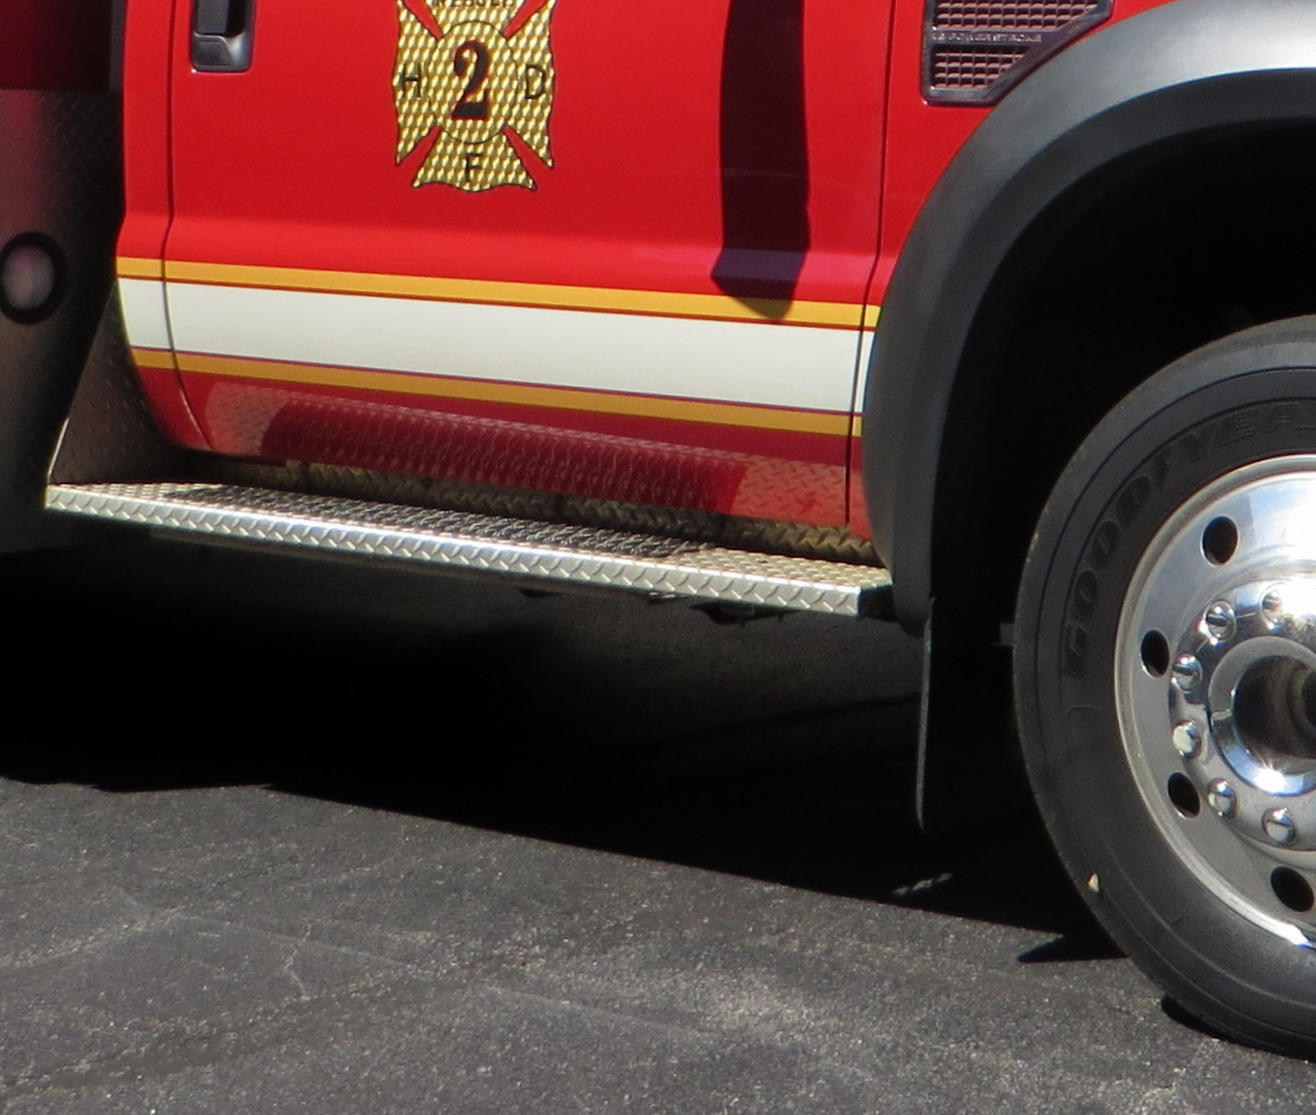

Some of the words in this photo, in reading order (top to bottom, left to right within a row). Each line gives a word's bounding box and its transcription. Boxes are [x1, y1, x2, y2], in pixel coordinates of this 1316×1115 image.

[400, 62, 422, 99] H
[450, 39, 489, 120] 2
[524, 64, 547, 99] D
[465, 153, 483, 183] F
